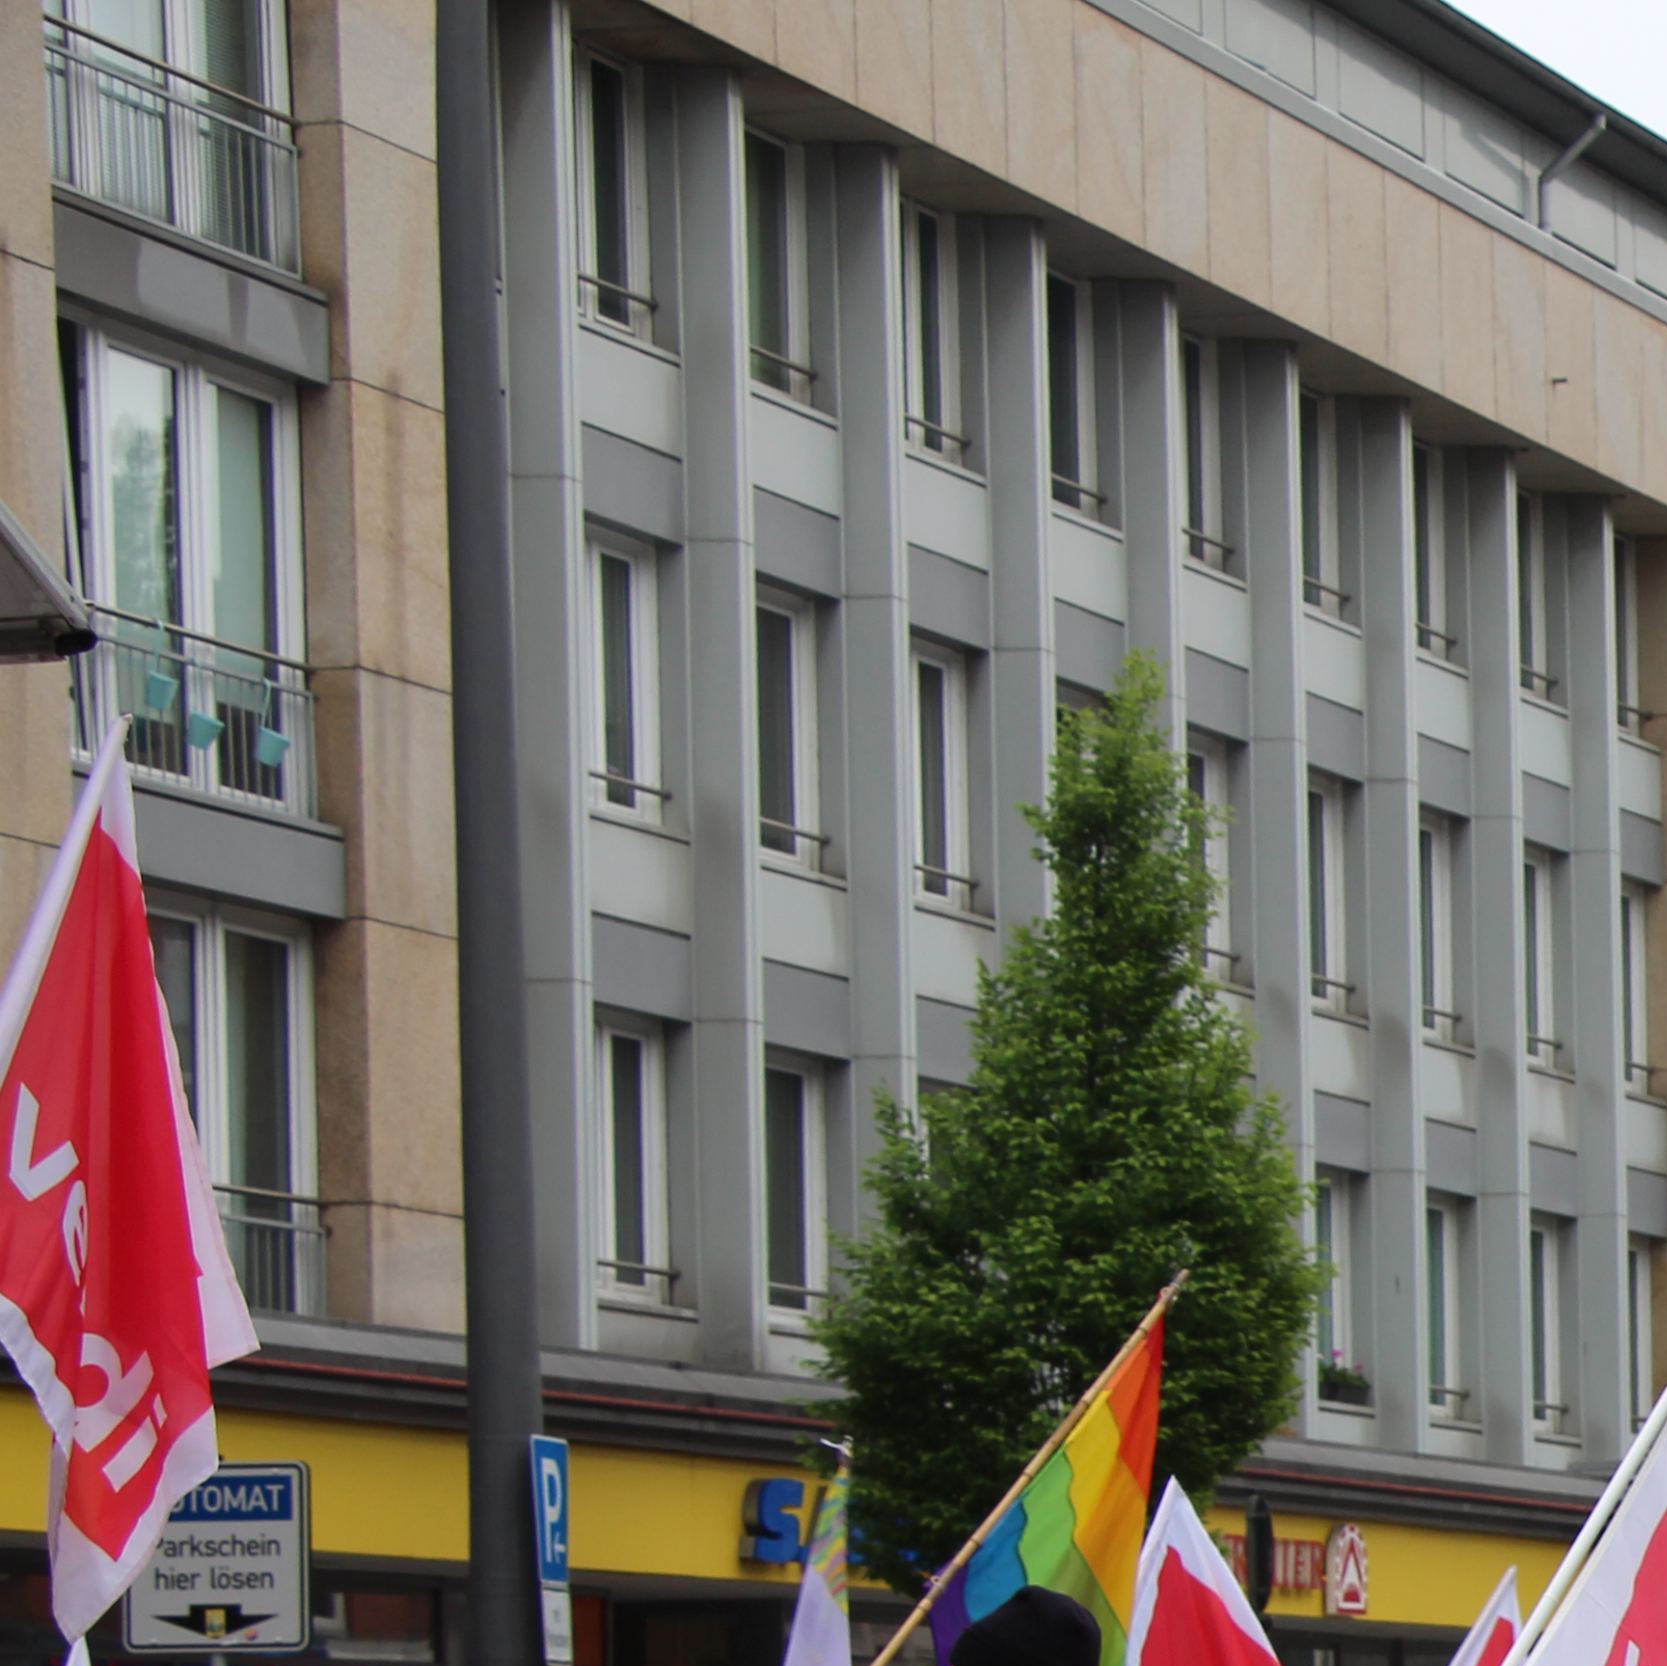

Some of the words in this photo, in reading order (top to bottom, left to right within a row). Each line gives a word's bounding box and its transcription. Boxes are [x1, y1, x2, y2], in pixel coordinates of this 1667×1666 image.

[540, 1456, 562, 1565] P
[157, 1532, 281, 1559] arkschein
[154, 1567, 201, 1591] hier
[210, 1565, 275, 1590] lösen
